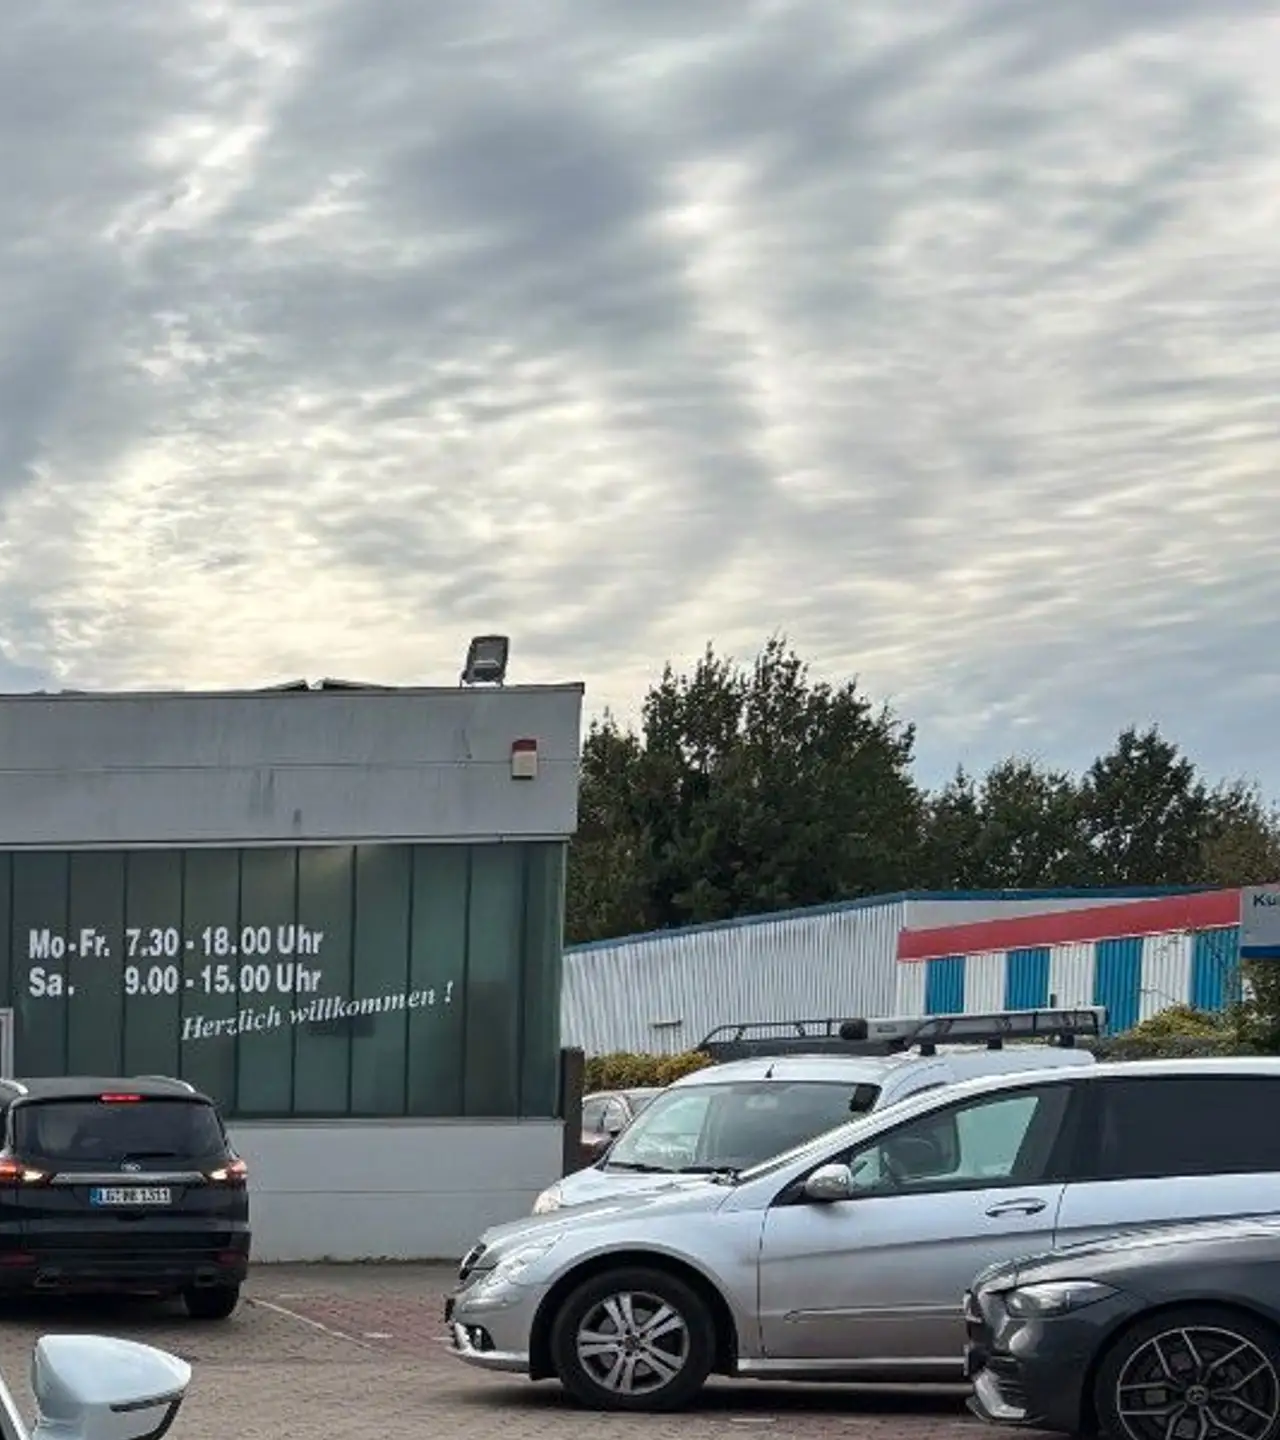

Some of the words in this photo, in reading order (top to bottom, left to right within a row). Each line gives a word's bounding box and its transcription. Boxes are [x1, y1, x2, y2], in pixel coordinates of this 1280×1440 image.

[125, 928, 178, 957] 7.30
[202, 926, 271, 956] 18.00
[276, 924, 324, 955] Uhr
[28, 966, 75, 998] Sa.
[124, 965, 178, 995] 9.00
[201, 964, 271, 994] 15.00
[276, 963, 322, 993] Uhr
[181, 1005, 282, 1041] Herzlich
[287, 989, 437, 1025] willkommen
